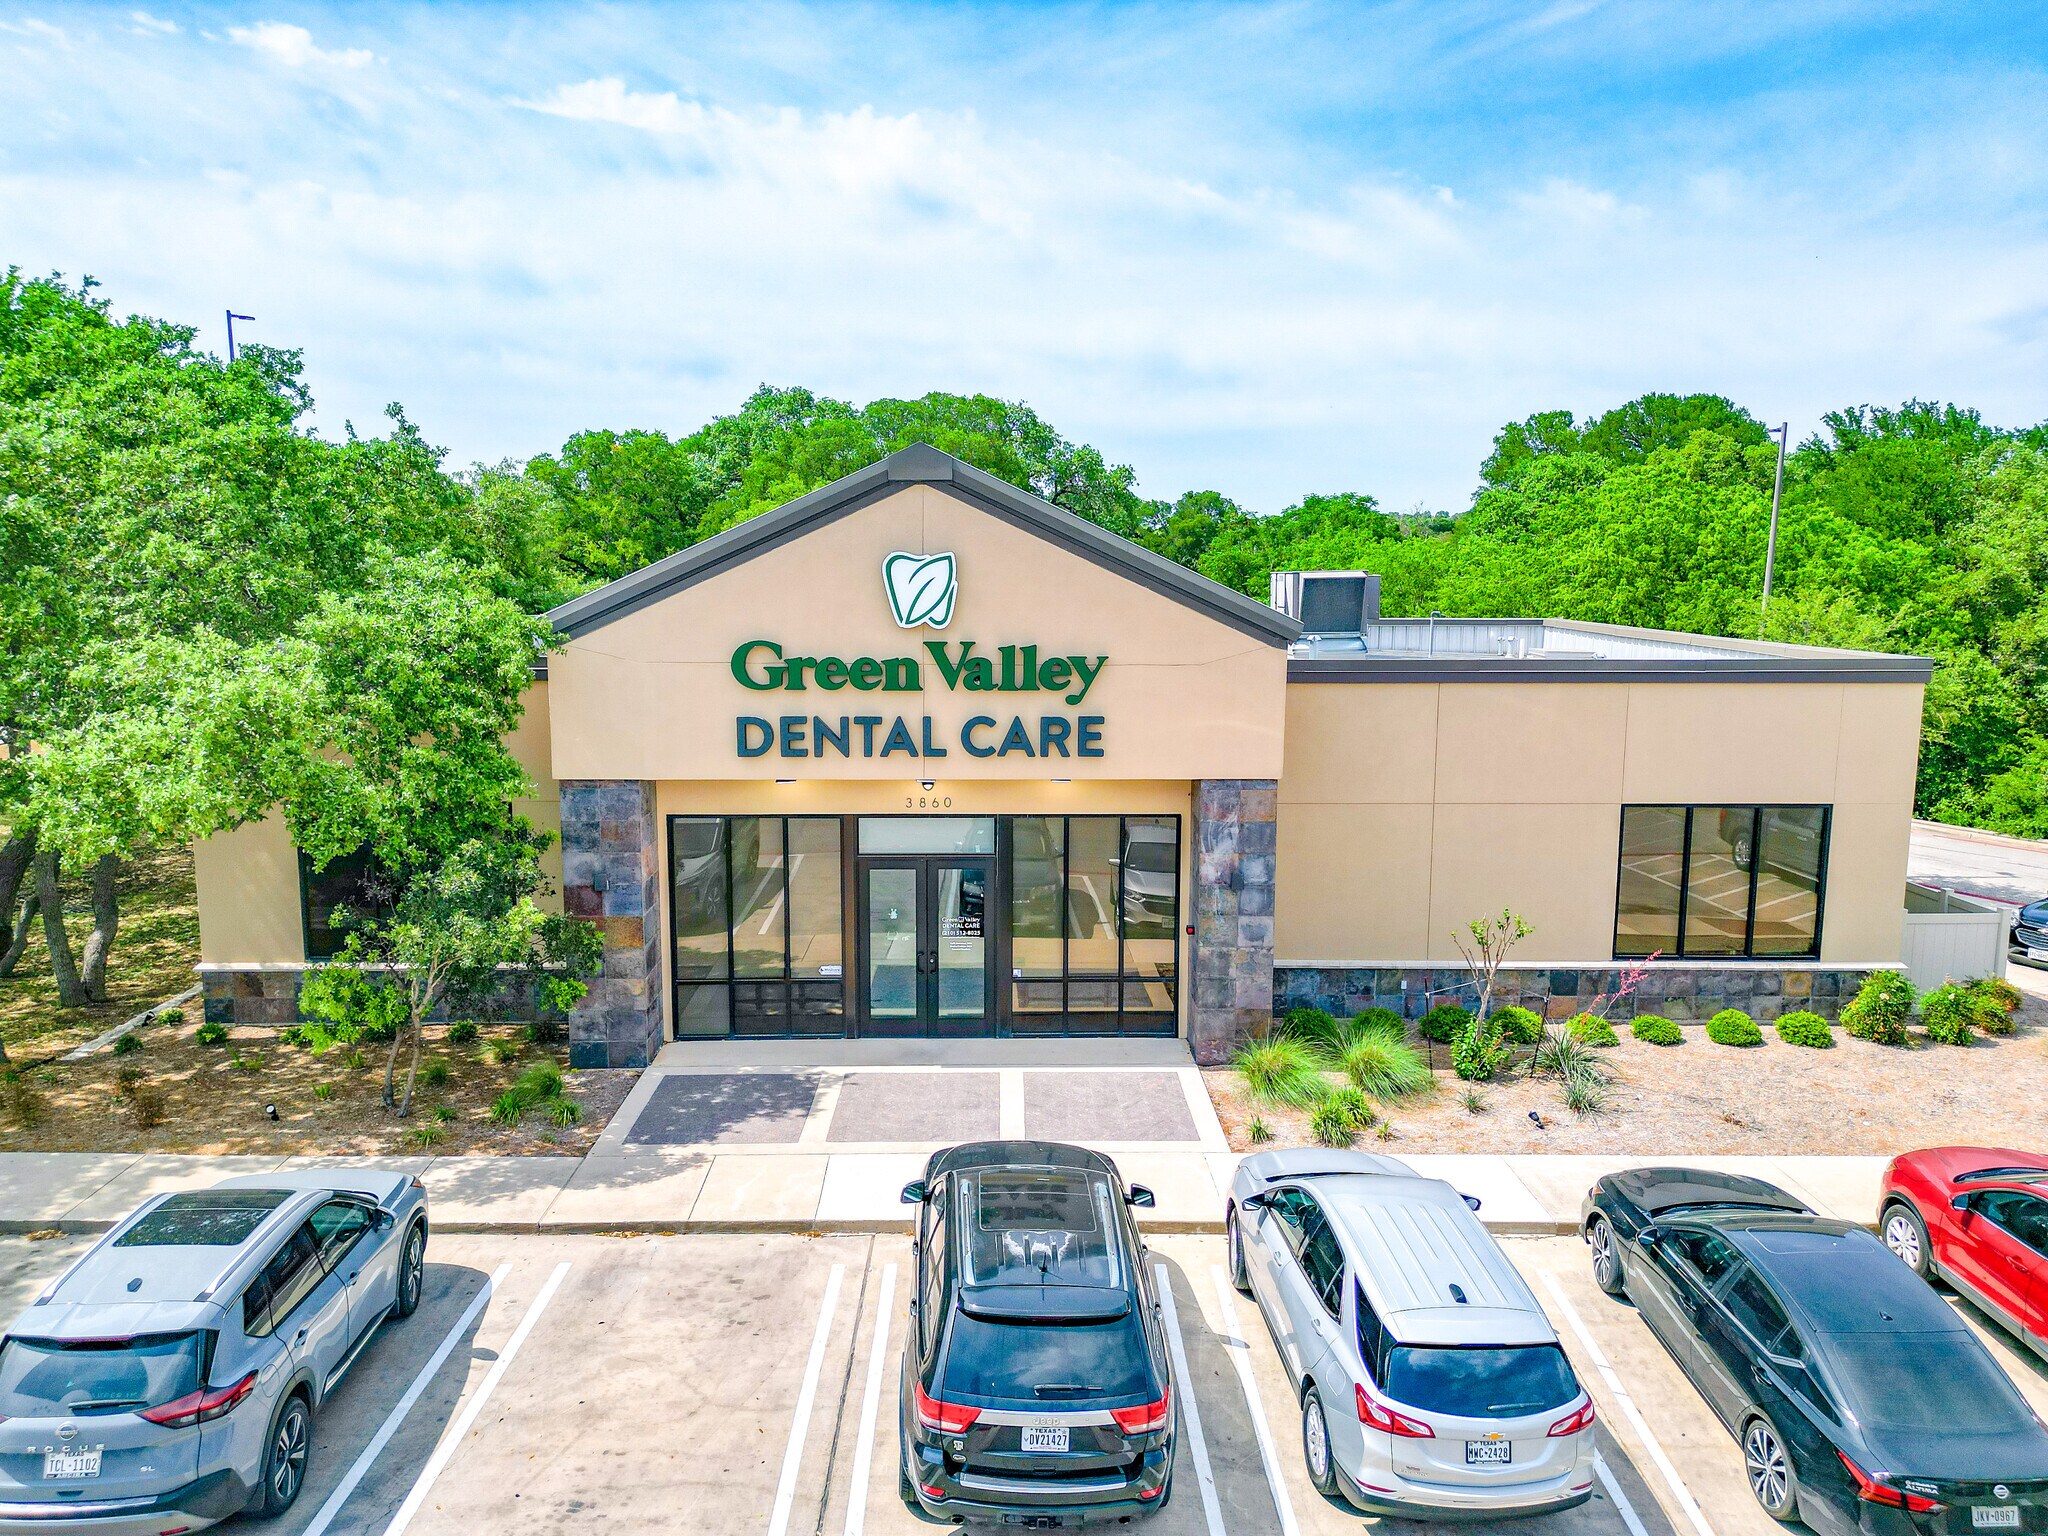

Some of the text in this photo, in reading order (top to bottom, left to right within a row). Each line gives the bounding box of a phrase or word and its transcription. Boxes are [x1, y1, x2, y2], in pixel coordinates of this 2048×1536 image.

[730, 640, 1109, 706] Green Valley
[736, 716, 1105, 758] DENTAL CARE
[905, 797, 952, 808] 3860
[1032, 1417, 1060, 1426] Jeep
[26, 1443, 105, 1453] ROGUE
[1905, 1484, 1940, 1496] ALTIMA
